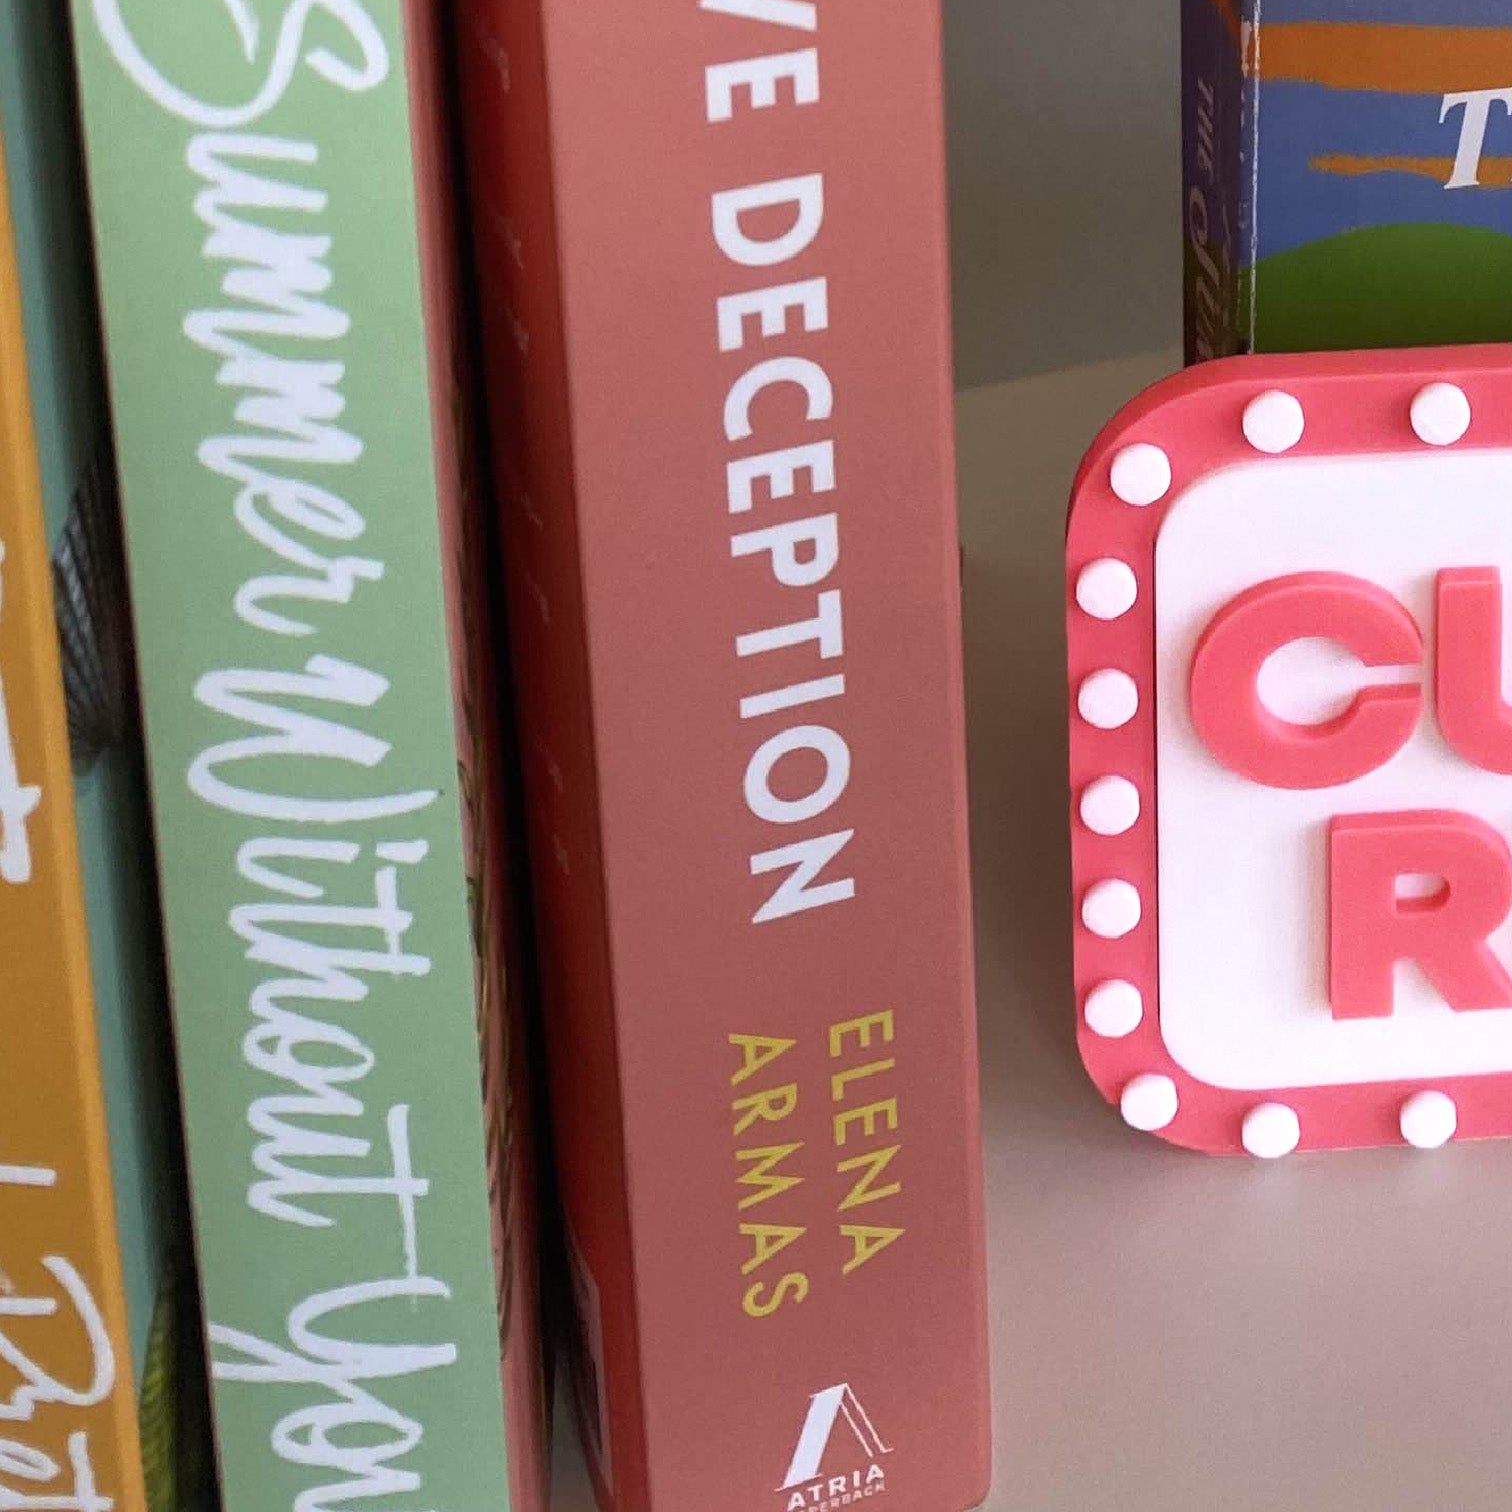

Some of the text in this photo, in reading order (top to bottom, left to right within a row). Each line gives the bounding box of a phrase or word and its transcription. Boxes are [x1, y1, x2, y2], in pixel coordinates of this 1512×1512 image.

[711, 173, 856, 925] DECEPTION
[187, 654, 440, 1276] Without
[728, 1033, 810, 1317] ARMAS
[829, 1009, 906, 1275] ELENA
[787, 1463, 885, 1511] ATRIA
